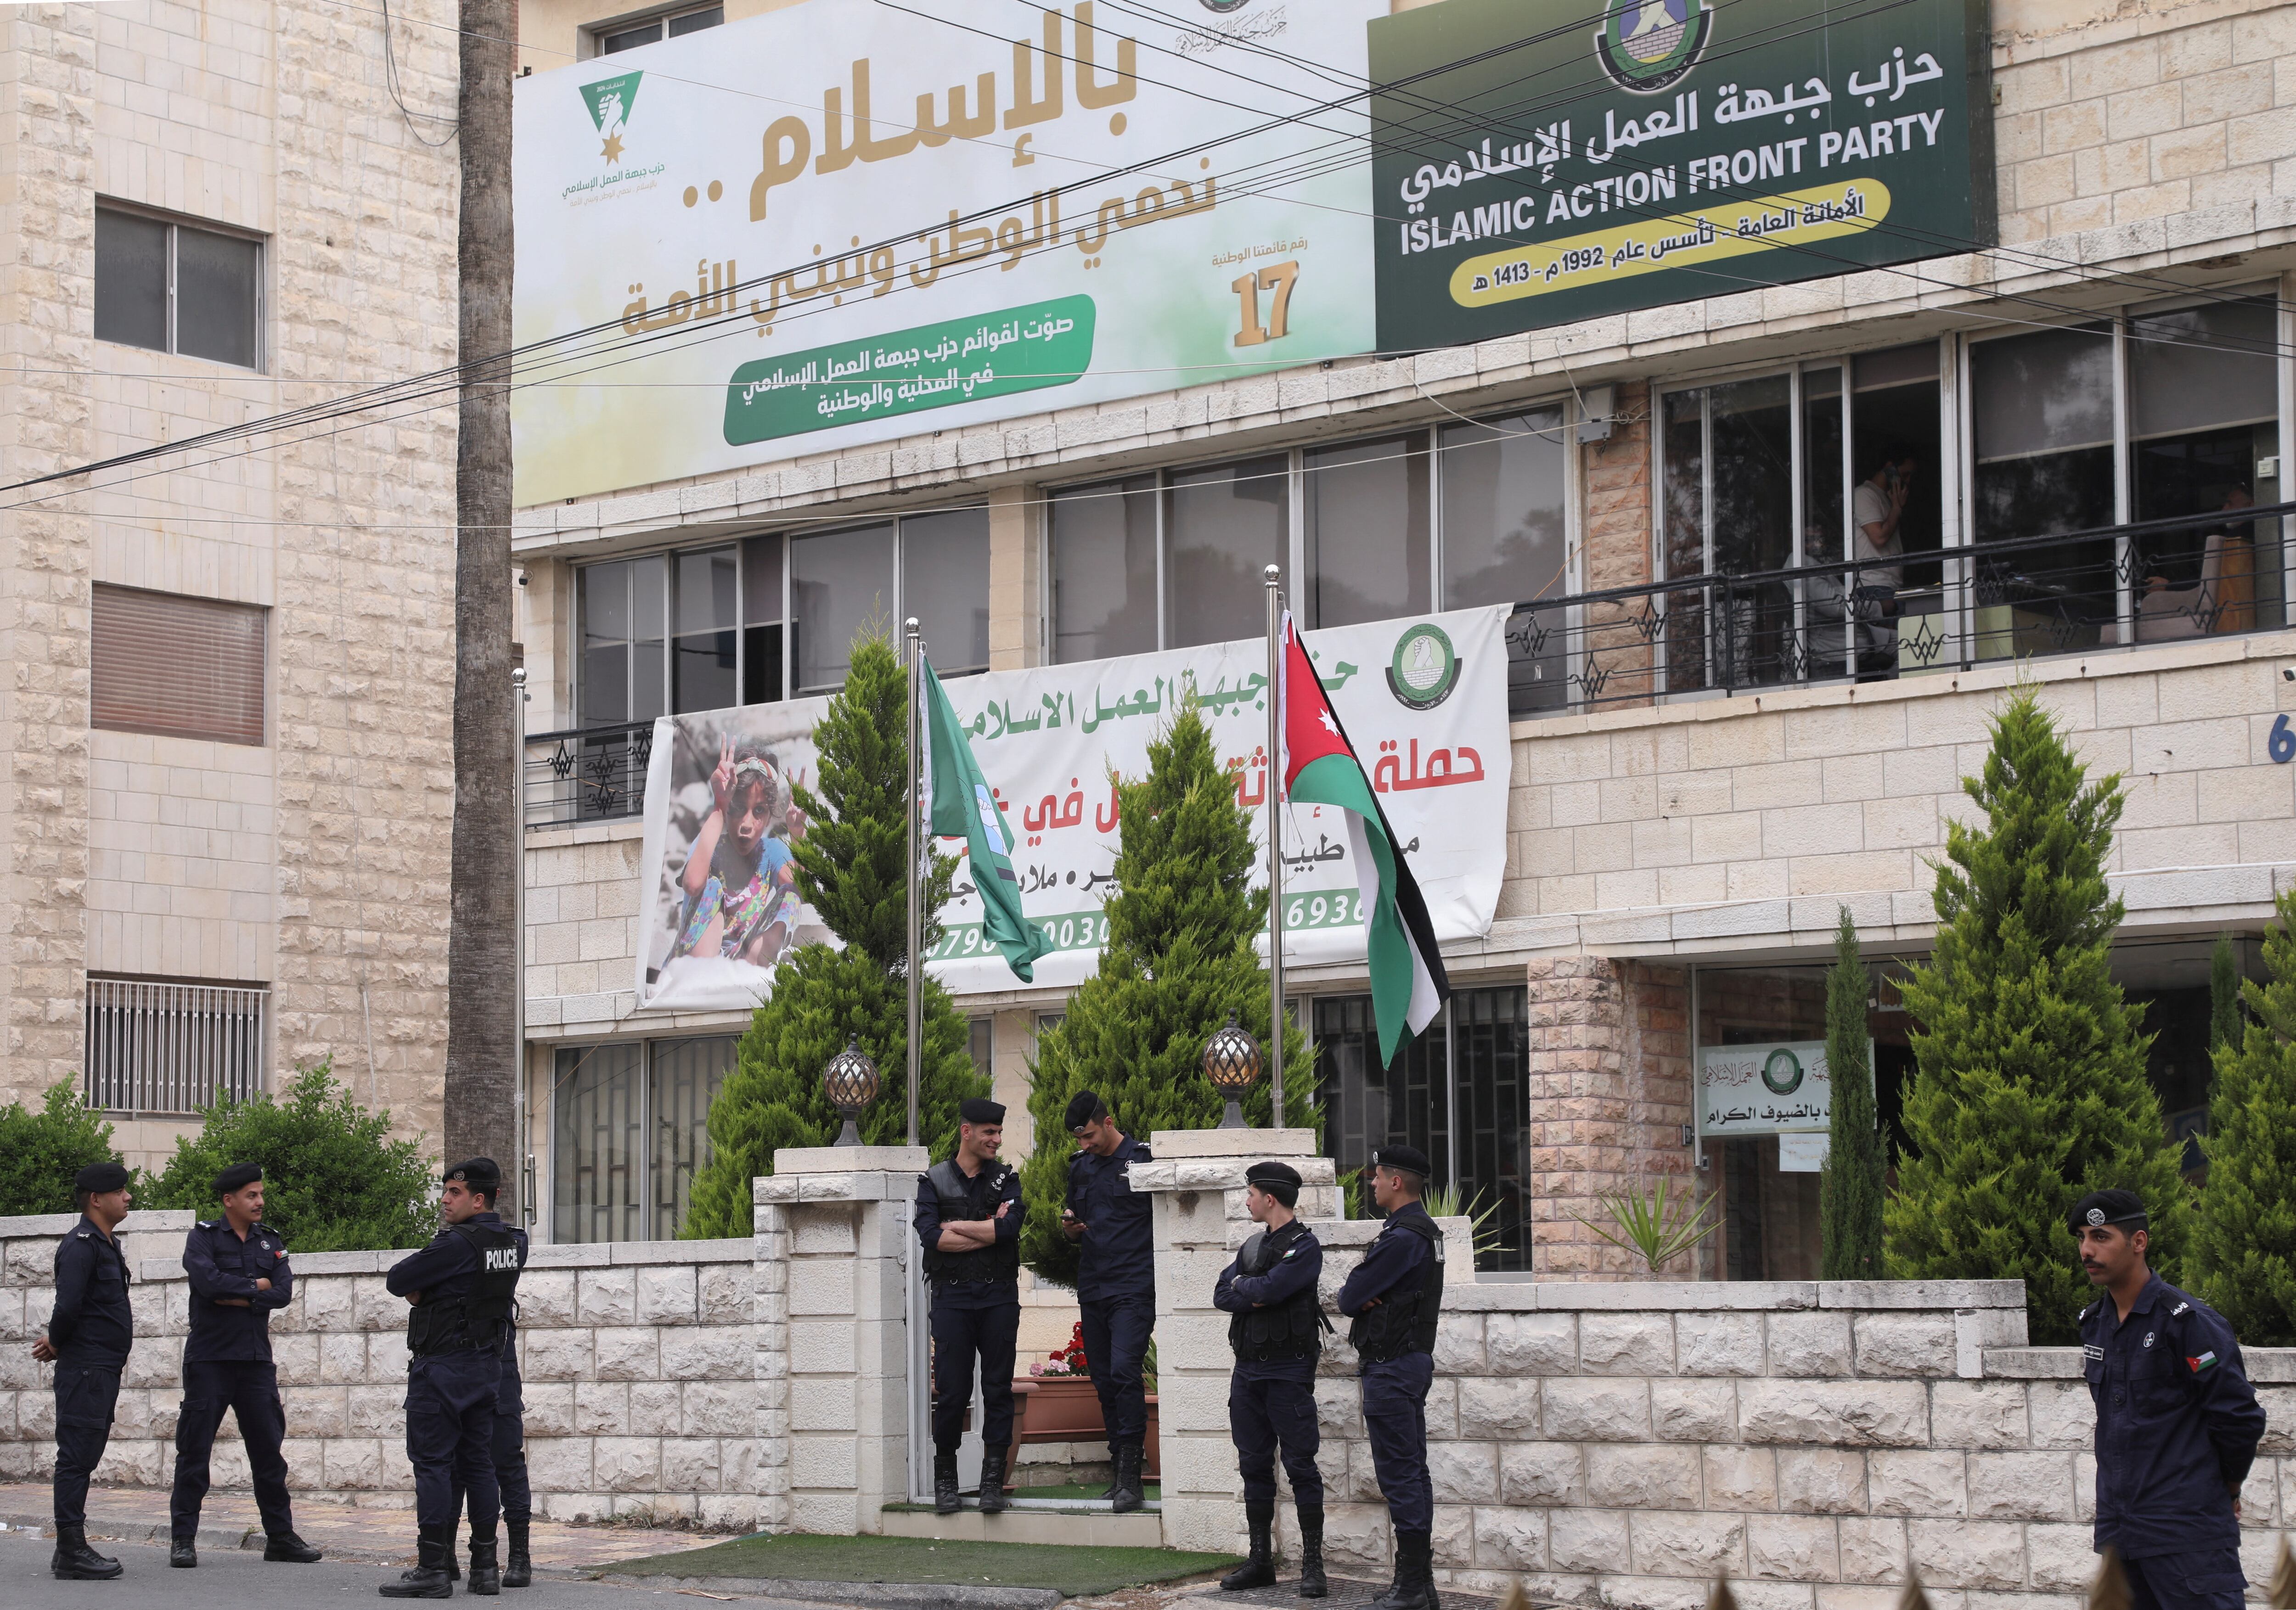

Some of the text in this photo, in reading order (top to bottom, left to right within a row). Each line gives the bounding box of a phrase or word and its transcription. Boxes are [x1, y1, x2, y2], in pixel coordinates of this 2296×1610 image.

[750, 0, 1137, 222] بالإسلام
[1401, 46, 1943, 214] حزب جبهة العمل الإسلامي
[562, 162, 665, 200] حزب جبهة العمل الإسلامي
[1401, 108, 1945, 255] ISLAMIC ACTION FRONT PARTY
[1075, 157, 1216, 270] نحمي
[1738, 208, 1795, 238] العامة
[1803, 187, 1864, 224] الأمانة
[909, 187, 1059, 289] الوطن
[1212, 236, 1308, 268] رقم قائمتنا الوطنية
[1611, 240, 1645, 269] عام
[1651, 219, 1715, 259] تأسس
[1494, 262, 1530, 286] 1413
[1562, 246, 1604, 272] 1992
[1232, 260, 1300, 347] 17
[874, 348, 920, 369] جبهة
[924, 336, 958, 363] حزب
[962, 320, 1019, 358] لقوائم
[743, 361, 816, 406] الإسلامي
[821, 350, 870, 384] العمل
[817, 362, 993, 418] في المحلية والوطنية
[962, 690, 1075, 743] الاسلام
[1081, 674, 1174, 734] العمل
[2269, 714, 2296, 763] 6
[1374, 738, 1485, 793] حملة
[1024, 778, 1084, 847] في
[1266, 833, 1345, 872] طبي
[1706, 1106, 1756, 1125] الكرام
[1761, 1103, 1821, 1122] بالضيوف
[486, 1248, 518, 1270] POLICE
